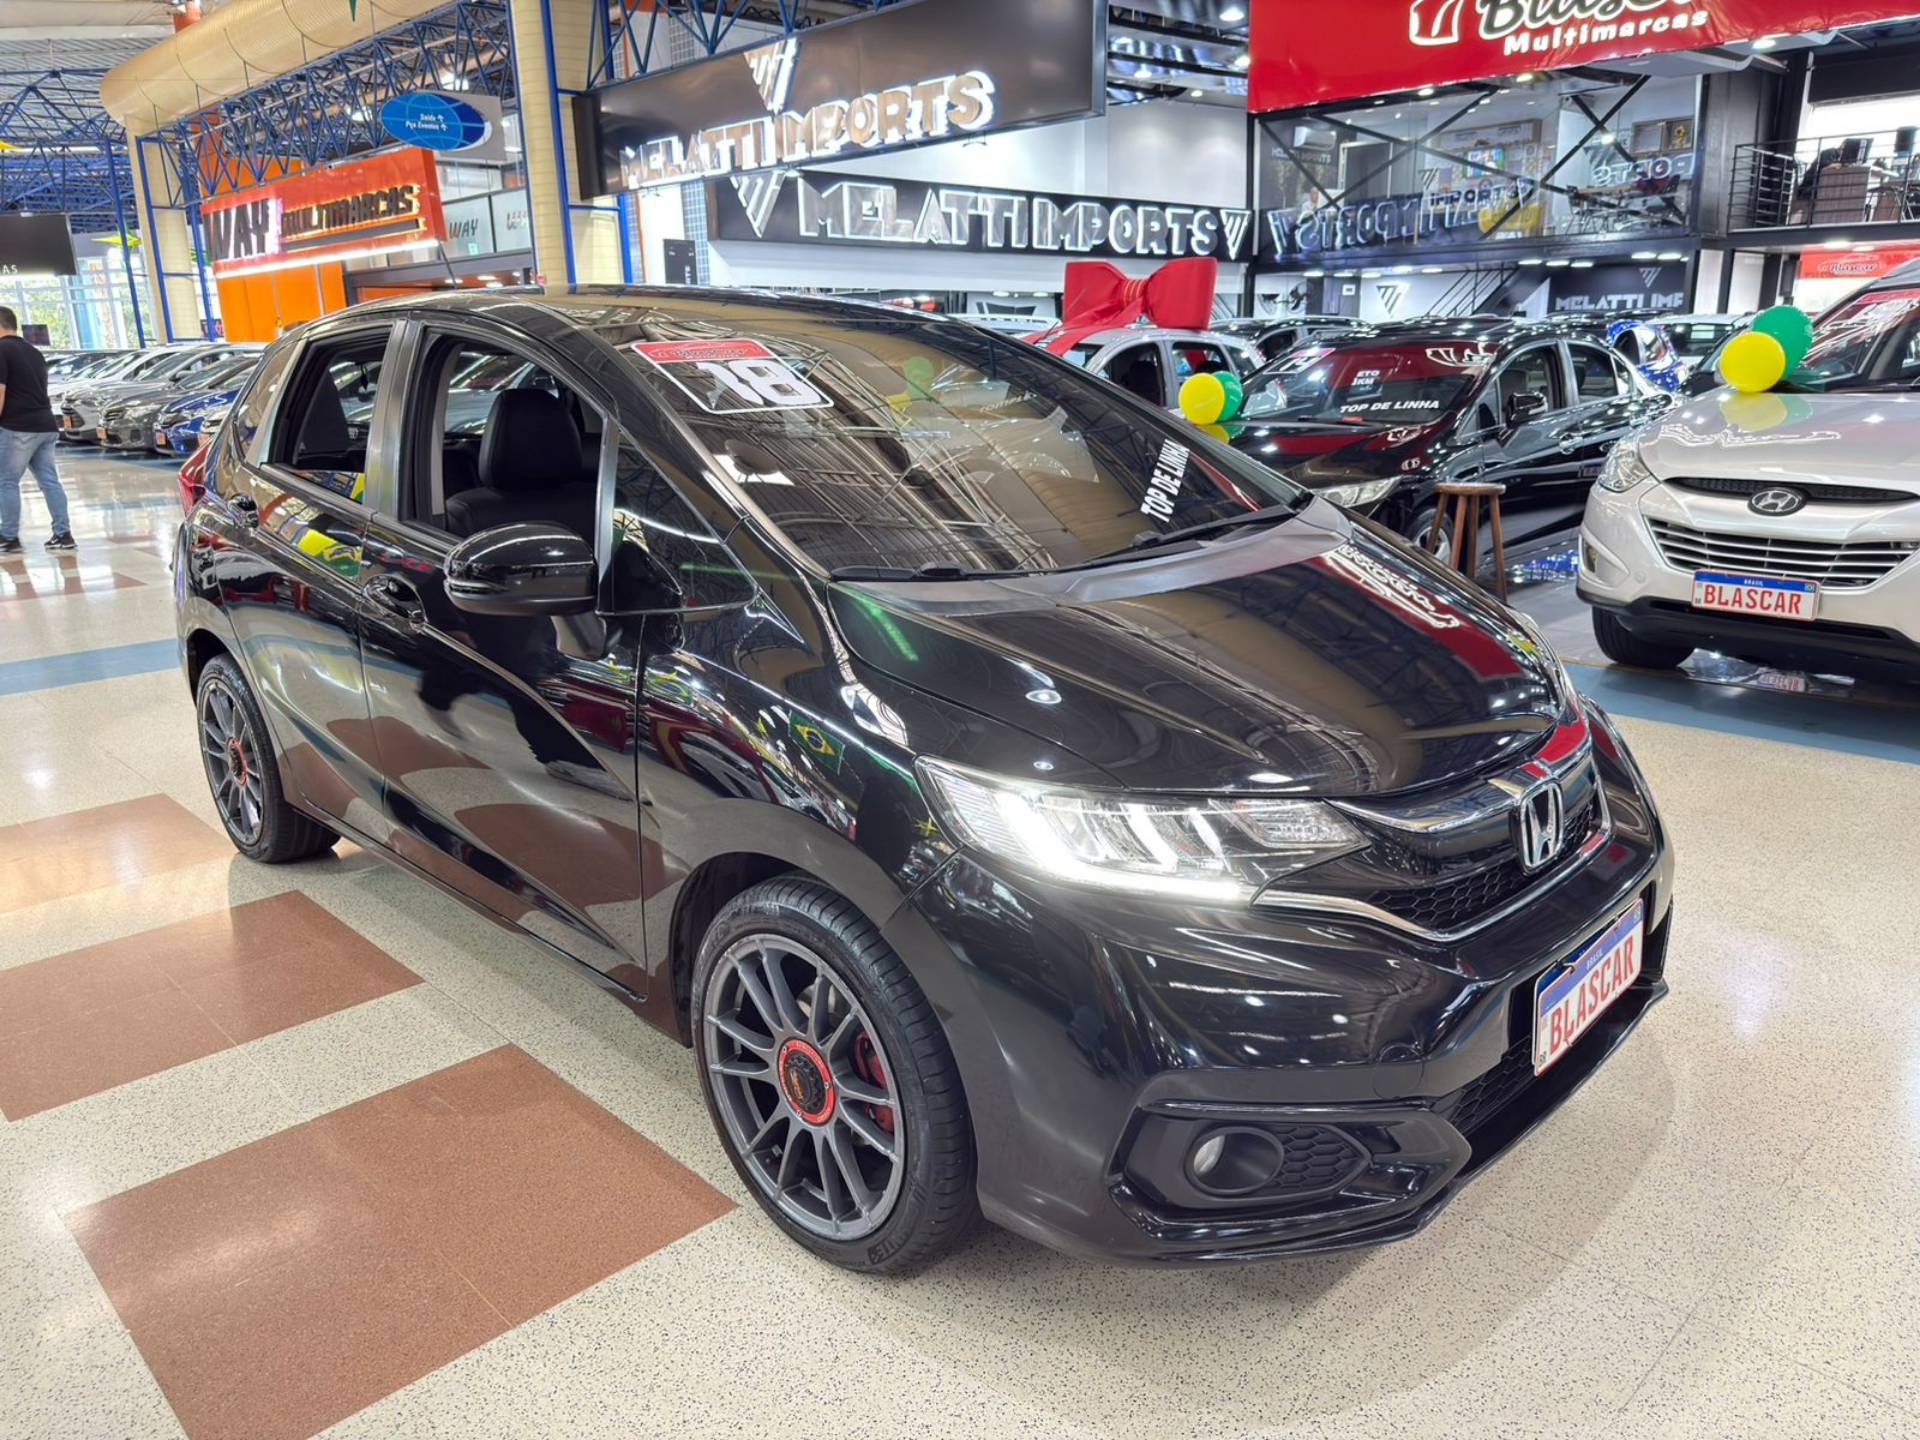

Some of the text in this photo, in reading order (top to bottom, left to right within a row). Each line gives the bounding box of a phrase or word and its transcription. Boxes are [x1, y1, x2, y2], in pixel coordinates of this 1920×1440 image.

[1503, 10, 1709, 56] Multimarcas
[620, 70, 995, 190] MELATTI IMPORTS
[202, 185, 416, 260] WAY MULTIMARCAS
[448, 218, 480, 240] WAY
[797, 176, 1219, 257] MELATTI IMPORTS
[1555, 293, 1645, 311] MELATTI
[696, 359, 822, 406] 18
[1339, 400, 1440, 414] TOP DE LINHA
[1140, 438, 1190, 523] TOP DE LINHA
[1703, 584, 1803, 615] BLASCAR
[1550, 935, 1635, 1055] BLASCAR
